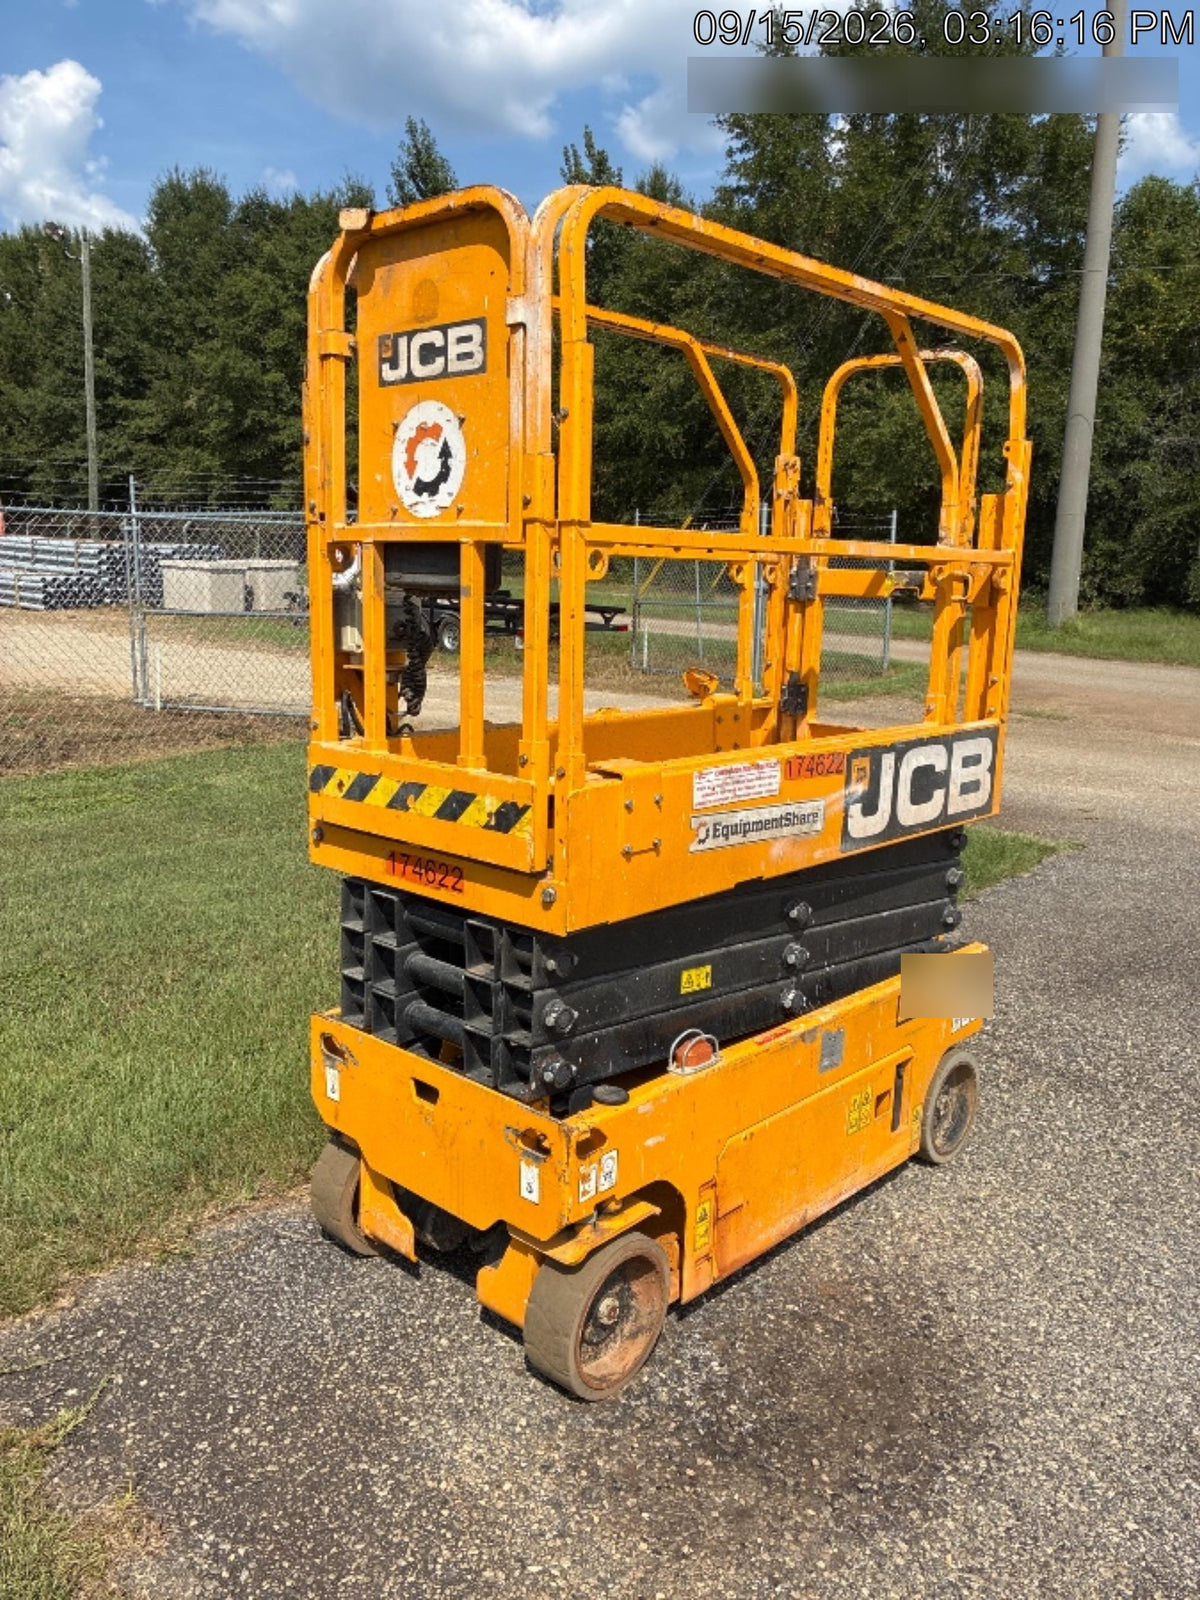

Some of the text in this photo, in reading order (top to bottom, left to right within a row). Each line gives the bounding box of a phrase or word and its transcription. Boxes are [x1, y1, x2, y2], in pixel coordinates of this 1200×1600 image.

[381, 323, 484, 382] JCB
[785, 752, 845, 779] 174622
[847, 737, 994, 839] JCB
[711, 811, 820, 842] EquipmentShare
[388, 850, 464, 892] 174622
